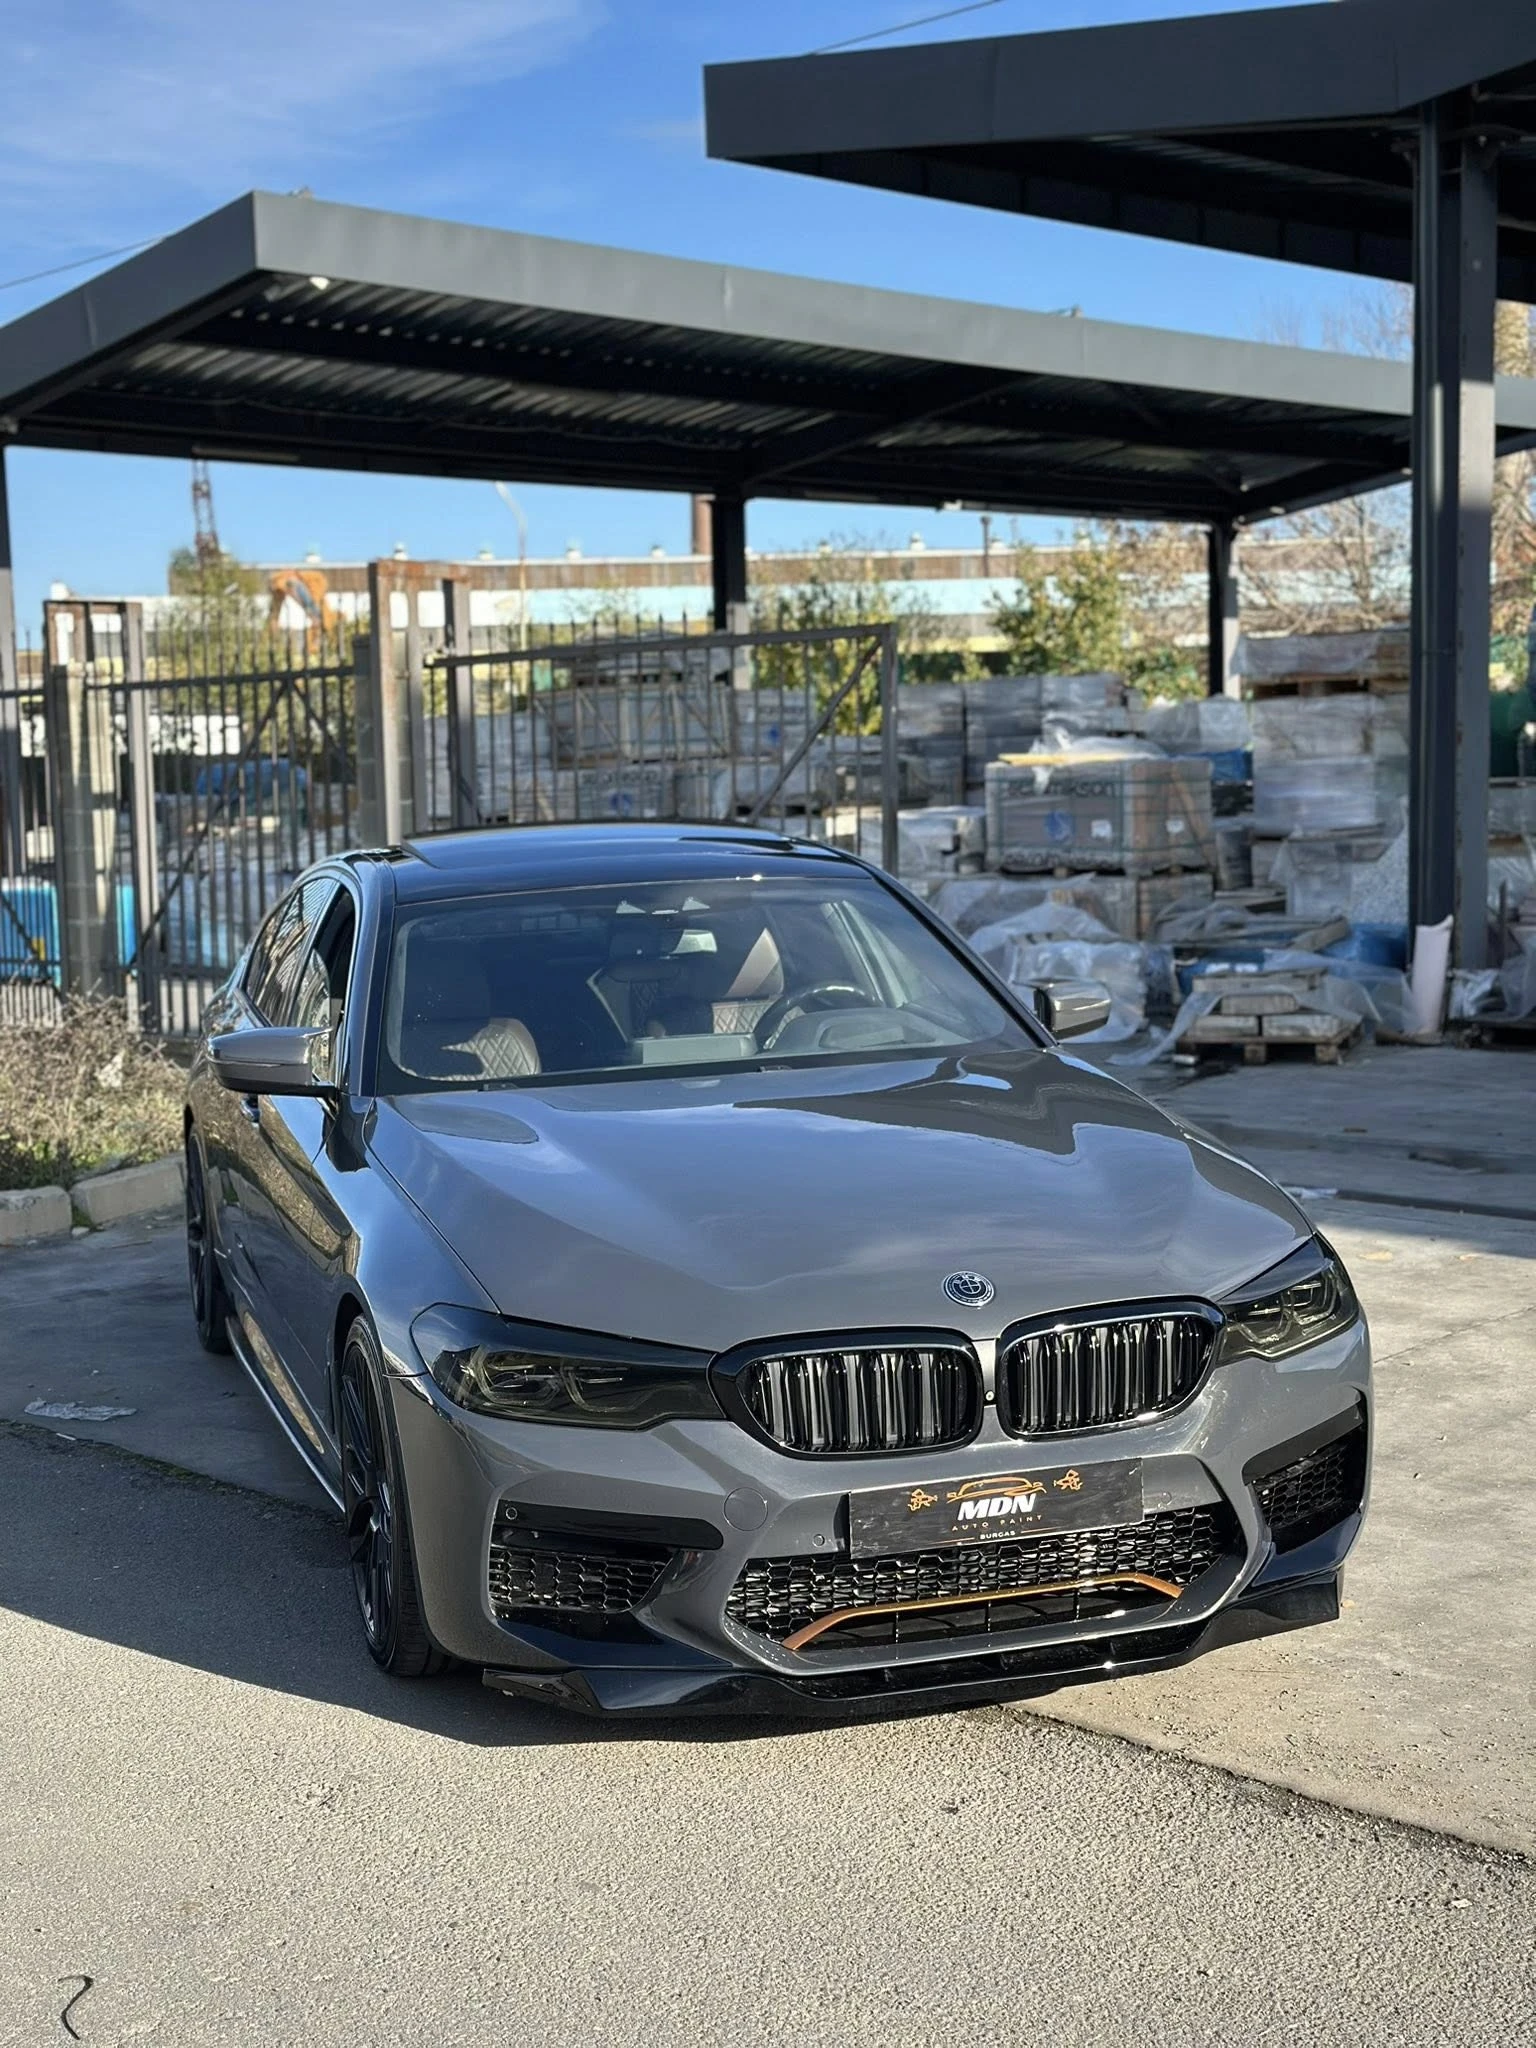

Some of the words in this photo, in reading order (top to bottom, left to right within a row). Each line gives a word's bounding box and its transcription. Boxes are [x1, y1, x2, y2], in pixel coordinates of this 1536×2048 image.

[958, 1494, 1037, 1521] MDN
[952, 1522, 989, 1531] AUTO
[1000, 1515, 1042, 1525] PAINT
[980, 1530, 1016, 1539] BURGAS
